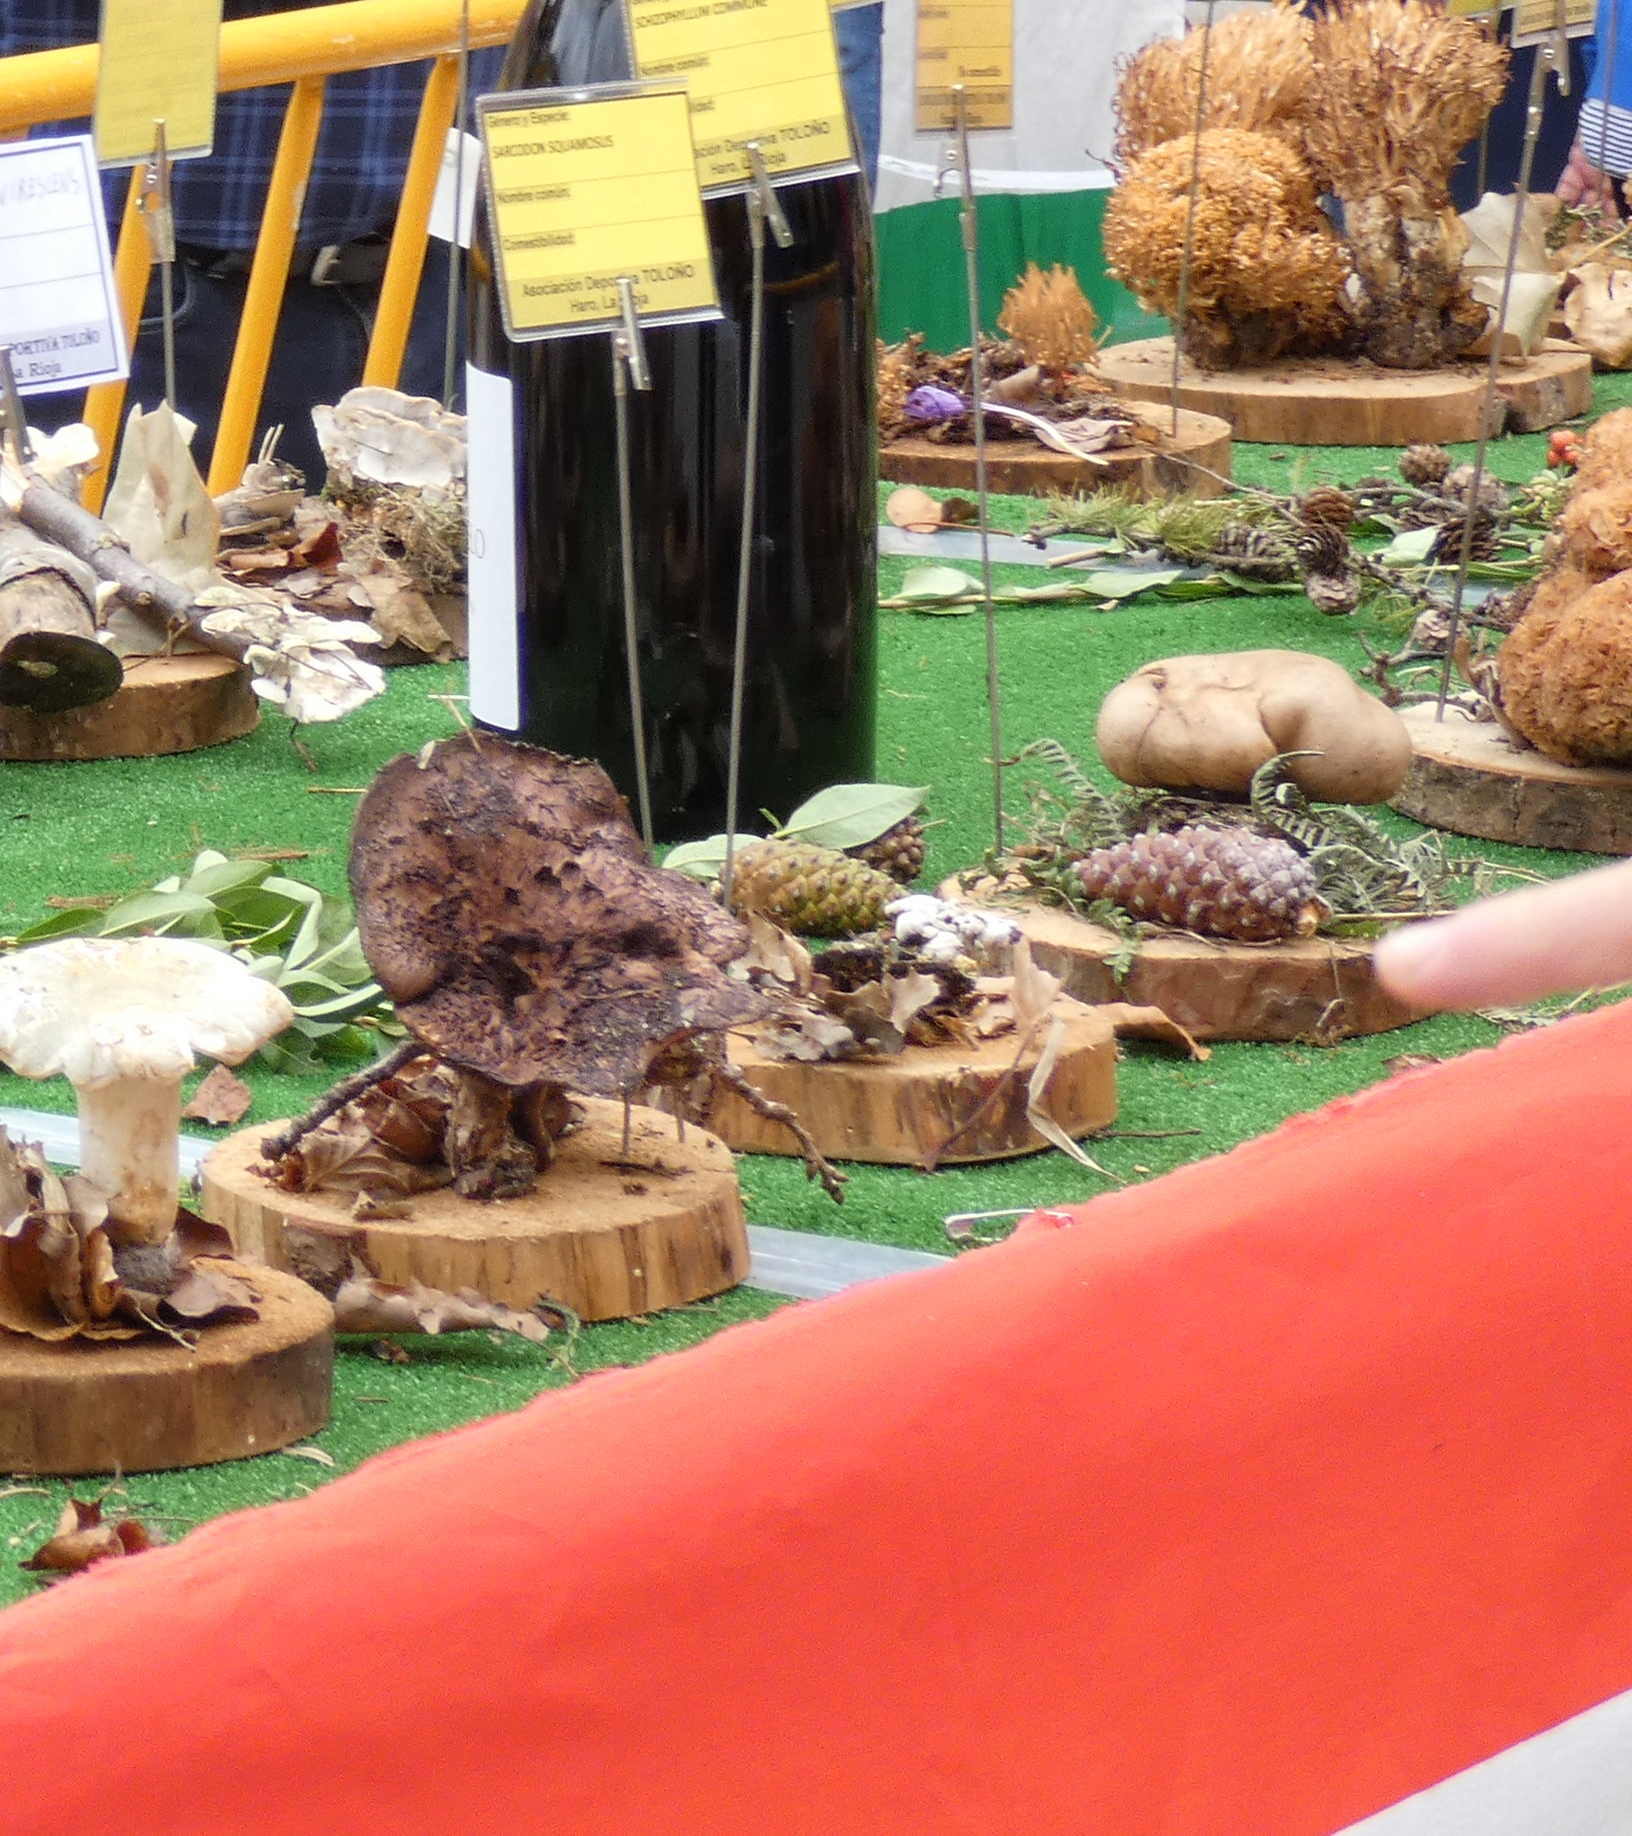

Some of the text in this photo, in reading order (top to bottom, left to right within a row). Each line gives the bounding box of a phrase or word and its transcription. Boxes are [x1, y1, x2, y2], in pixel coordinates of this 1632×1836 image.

[780, 120, 831, 141] TOLOÑO
[522, 278, 583, 296] Asociación
[642, 264, 695, 284] TOLOÑO
[61, 329, 100, 352] TOLOÑO
[29, 359, 63, 378] Rioja
